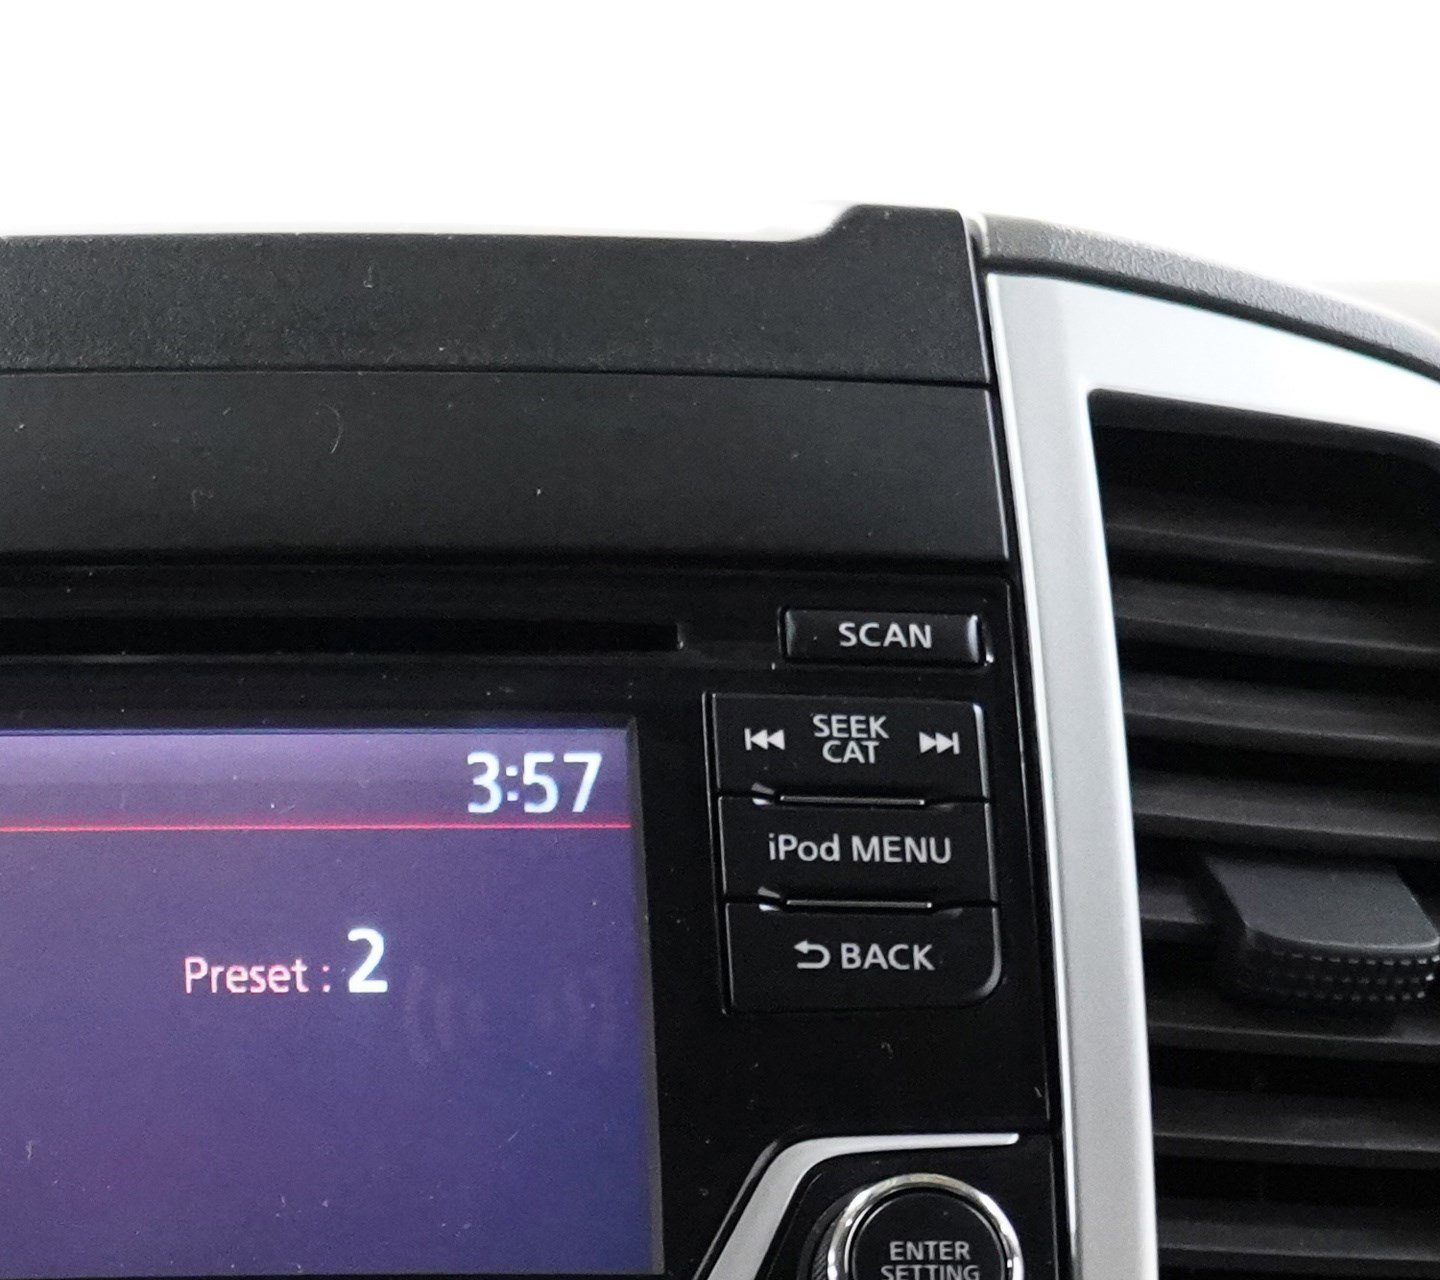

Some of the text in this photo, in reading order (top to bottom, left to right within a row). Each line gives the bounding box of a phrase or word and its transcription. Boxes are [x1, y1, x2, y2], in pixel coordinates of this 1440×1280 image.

[838, 621, 932, 649] SCAN
[811, 713, 890, 740] SEEK
[822, 739, 880, 764] CAT
[465, 750, 604, 815] 3:57
[768, 832, 952, 864] iPod MENU
[347, 926, 389, 994] 2
[840, 942, 935, 971] BACK
[889, 1240, 971, 1261] ENTER
